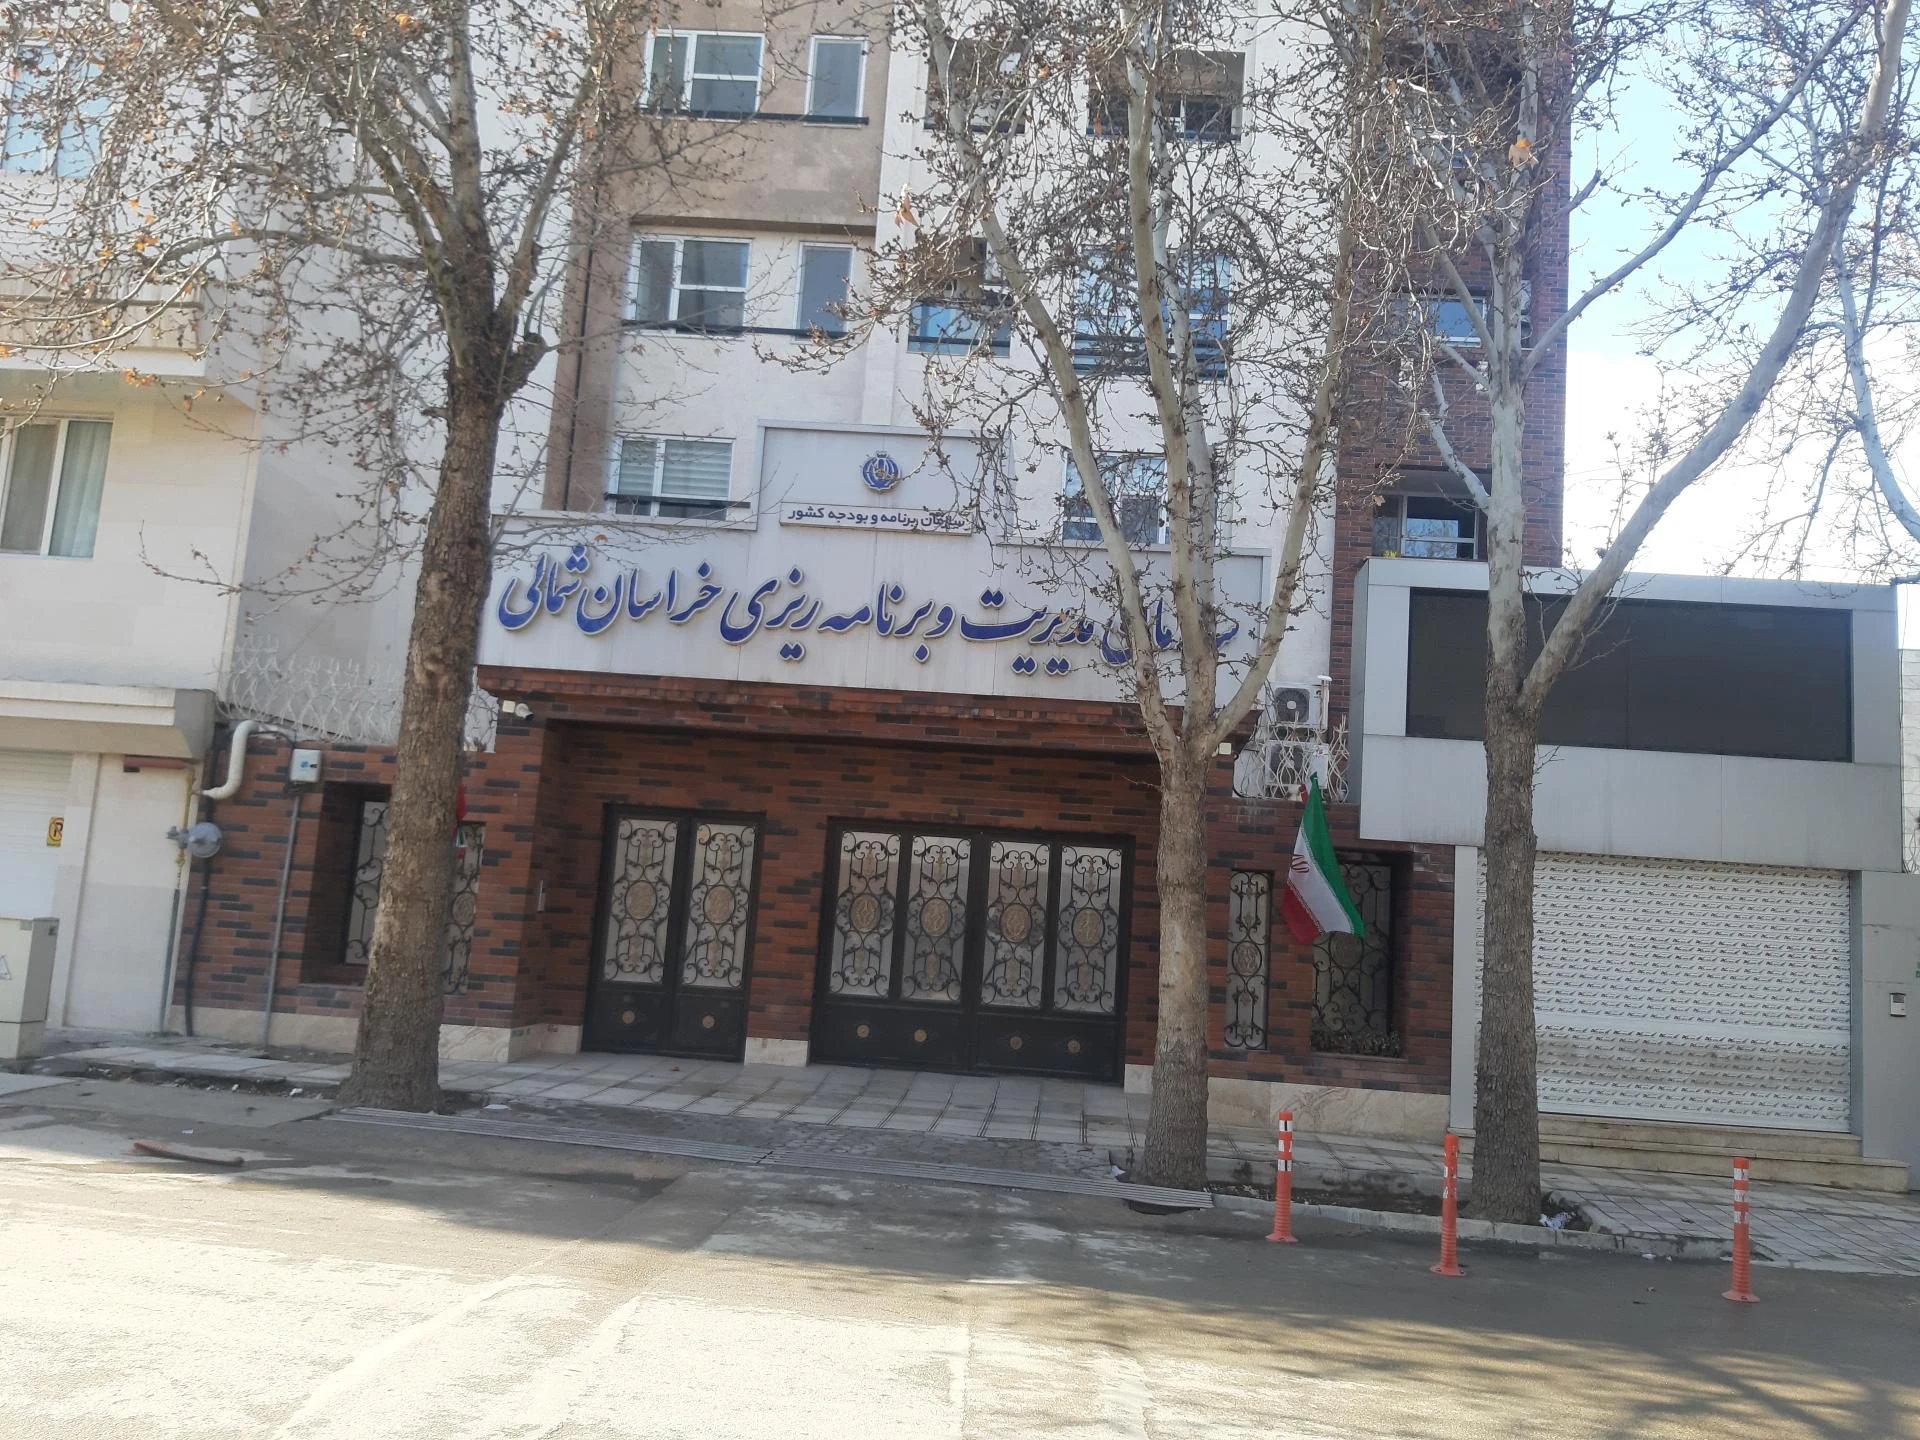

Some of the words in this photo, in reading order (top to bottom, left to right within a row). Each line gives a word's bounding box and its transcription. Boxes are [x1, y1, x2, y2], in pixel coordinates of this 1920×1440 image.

[787, 505, 825, 521] کشور
[827, 510, 869, 524] بودجه
[870, 513, 878, 525] و
[880, 512, 919, 527] برنامه
[497, 543, 591, 631] شمالی
[575, 560, 724, 636] خراسان
[923, 603, 956, 638] و
[959, 586, 1095, 676] مدیریت
